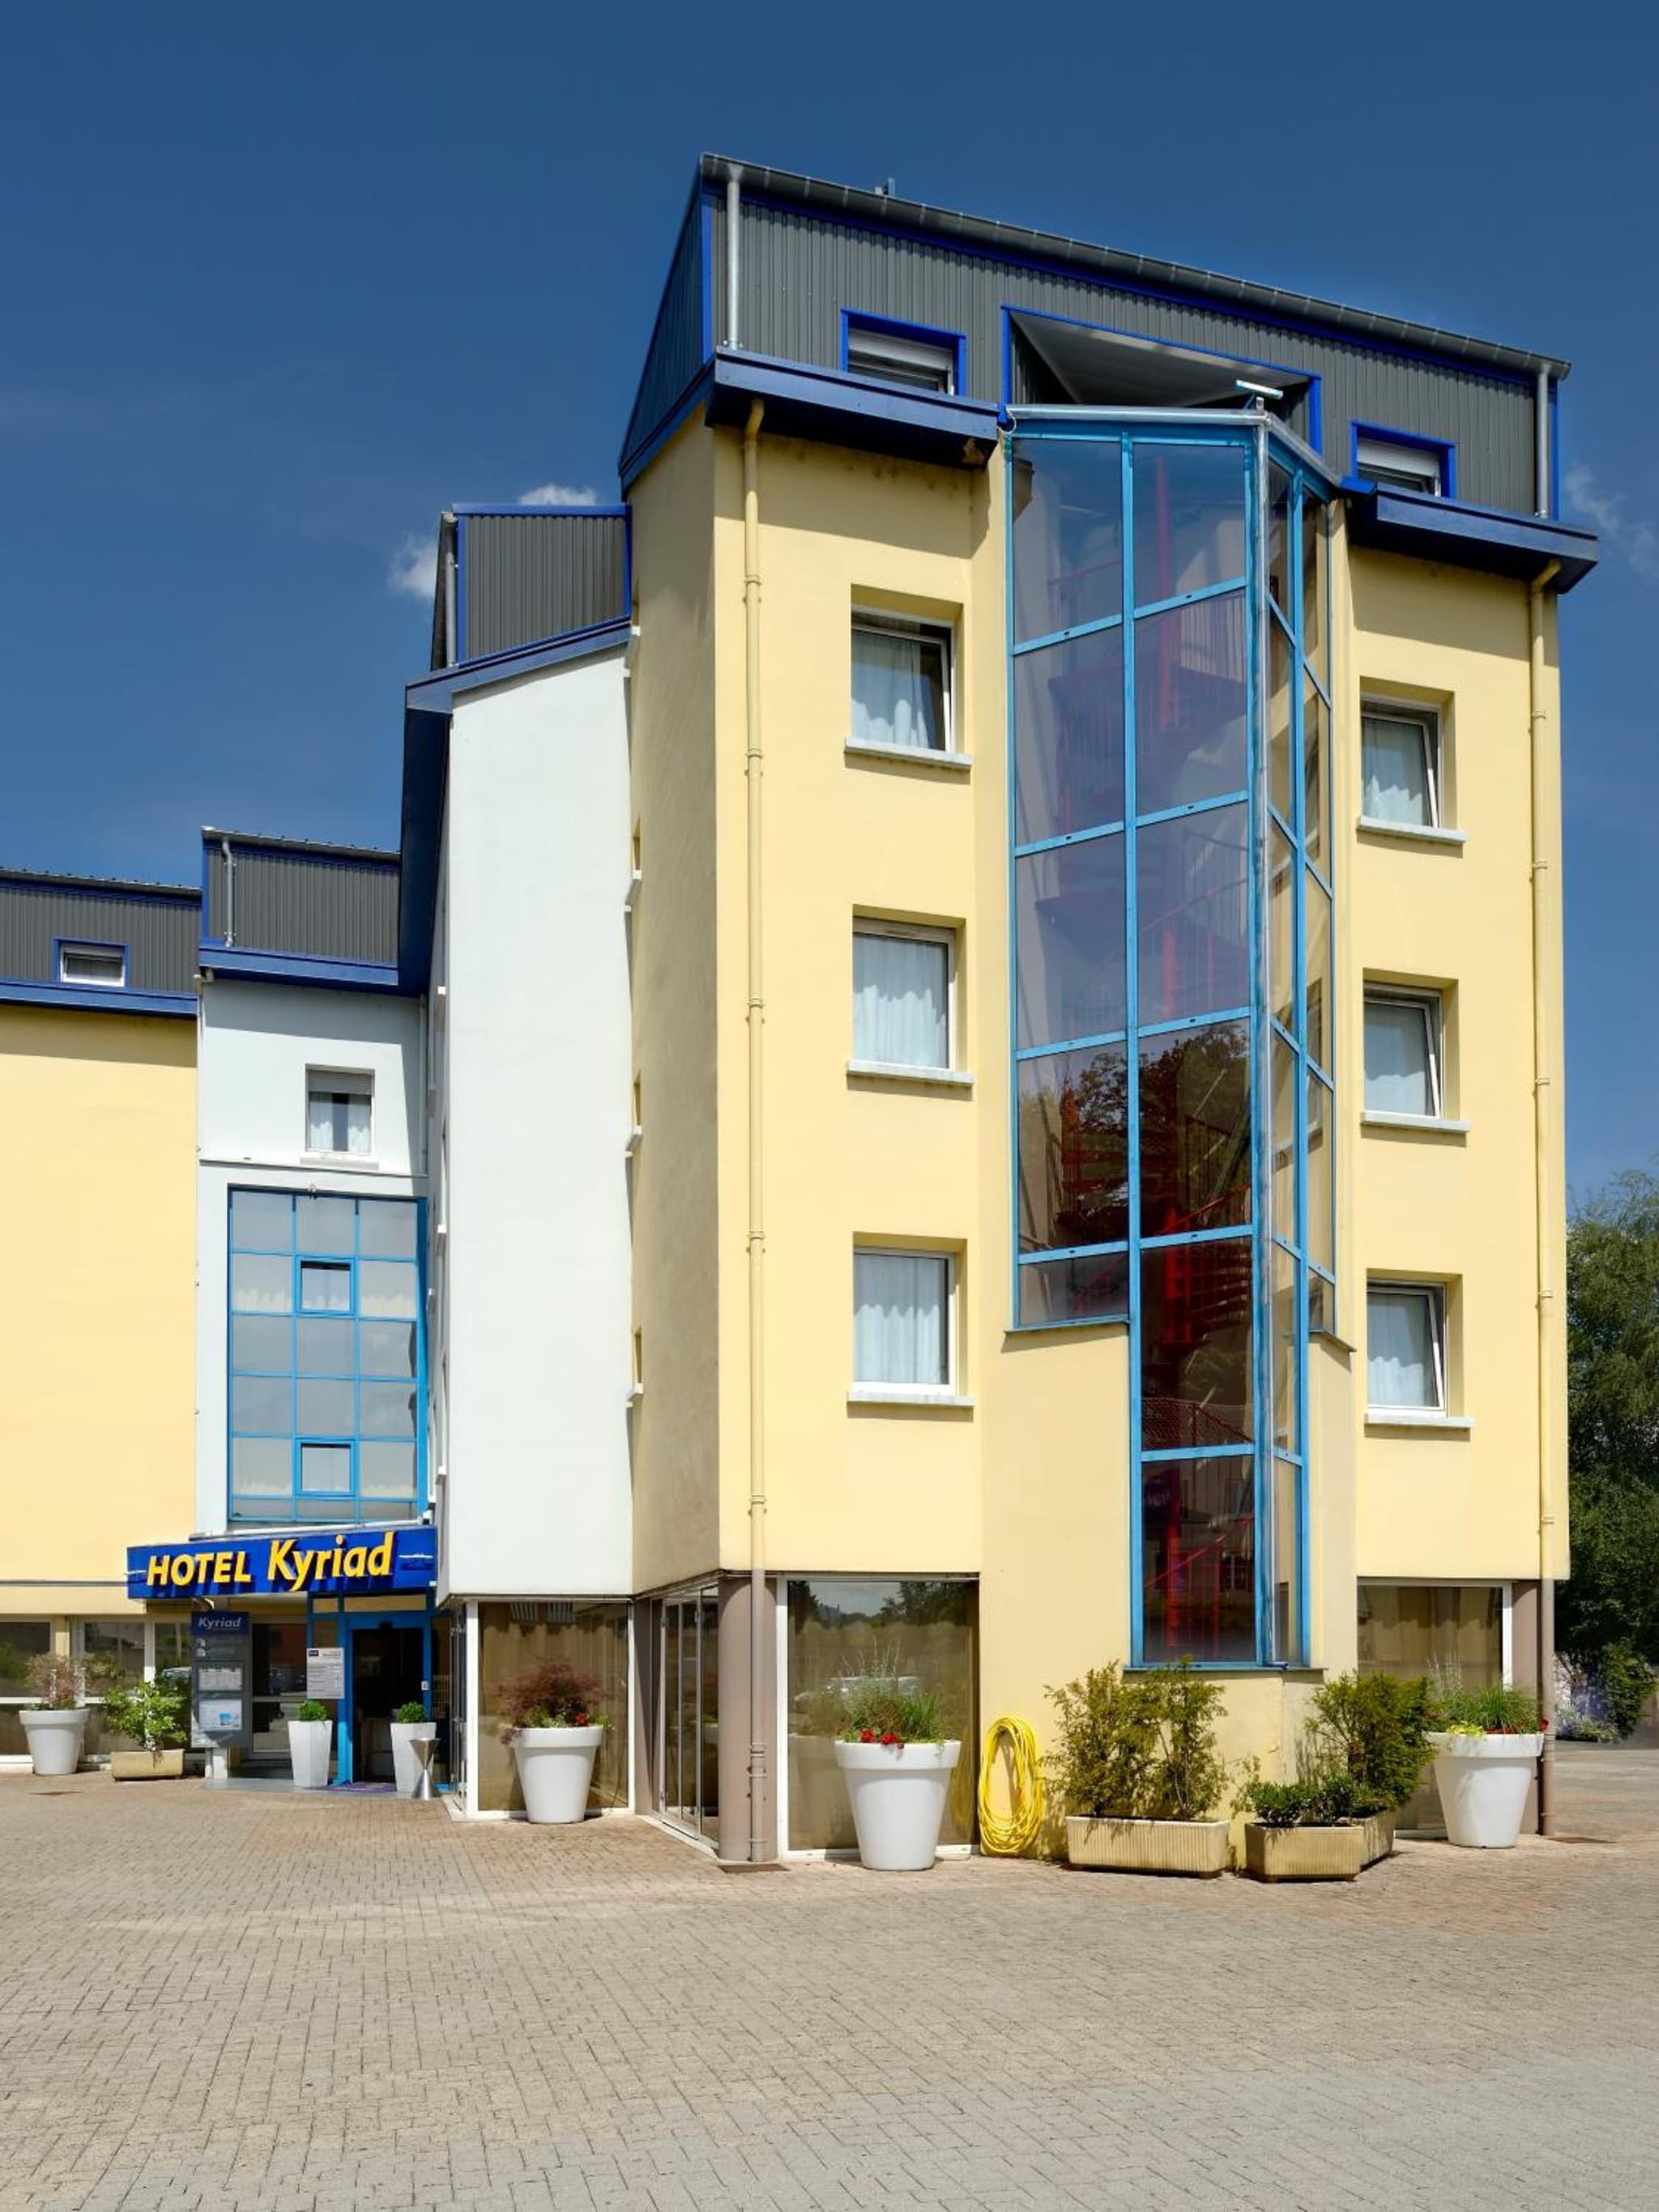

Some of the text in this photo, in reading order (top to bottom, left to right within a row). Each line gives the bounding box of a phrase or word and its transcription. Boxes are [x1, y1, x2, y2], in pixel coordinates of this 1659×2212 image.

[147, 1532, 394, 1592] HOTEL Kyriad
[198, 1616, 241, 1629] Kyriad
